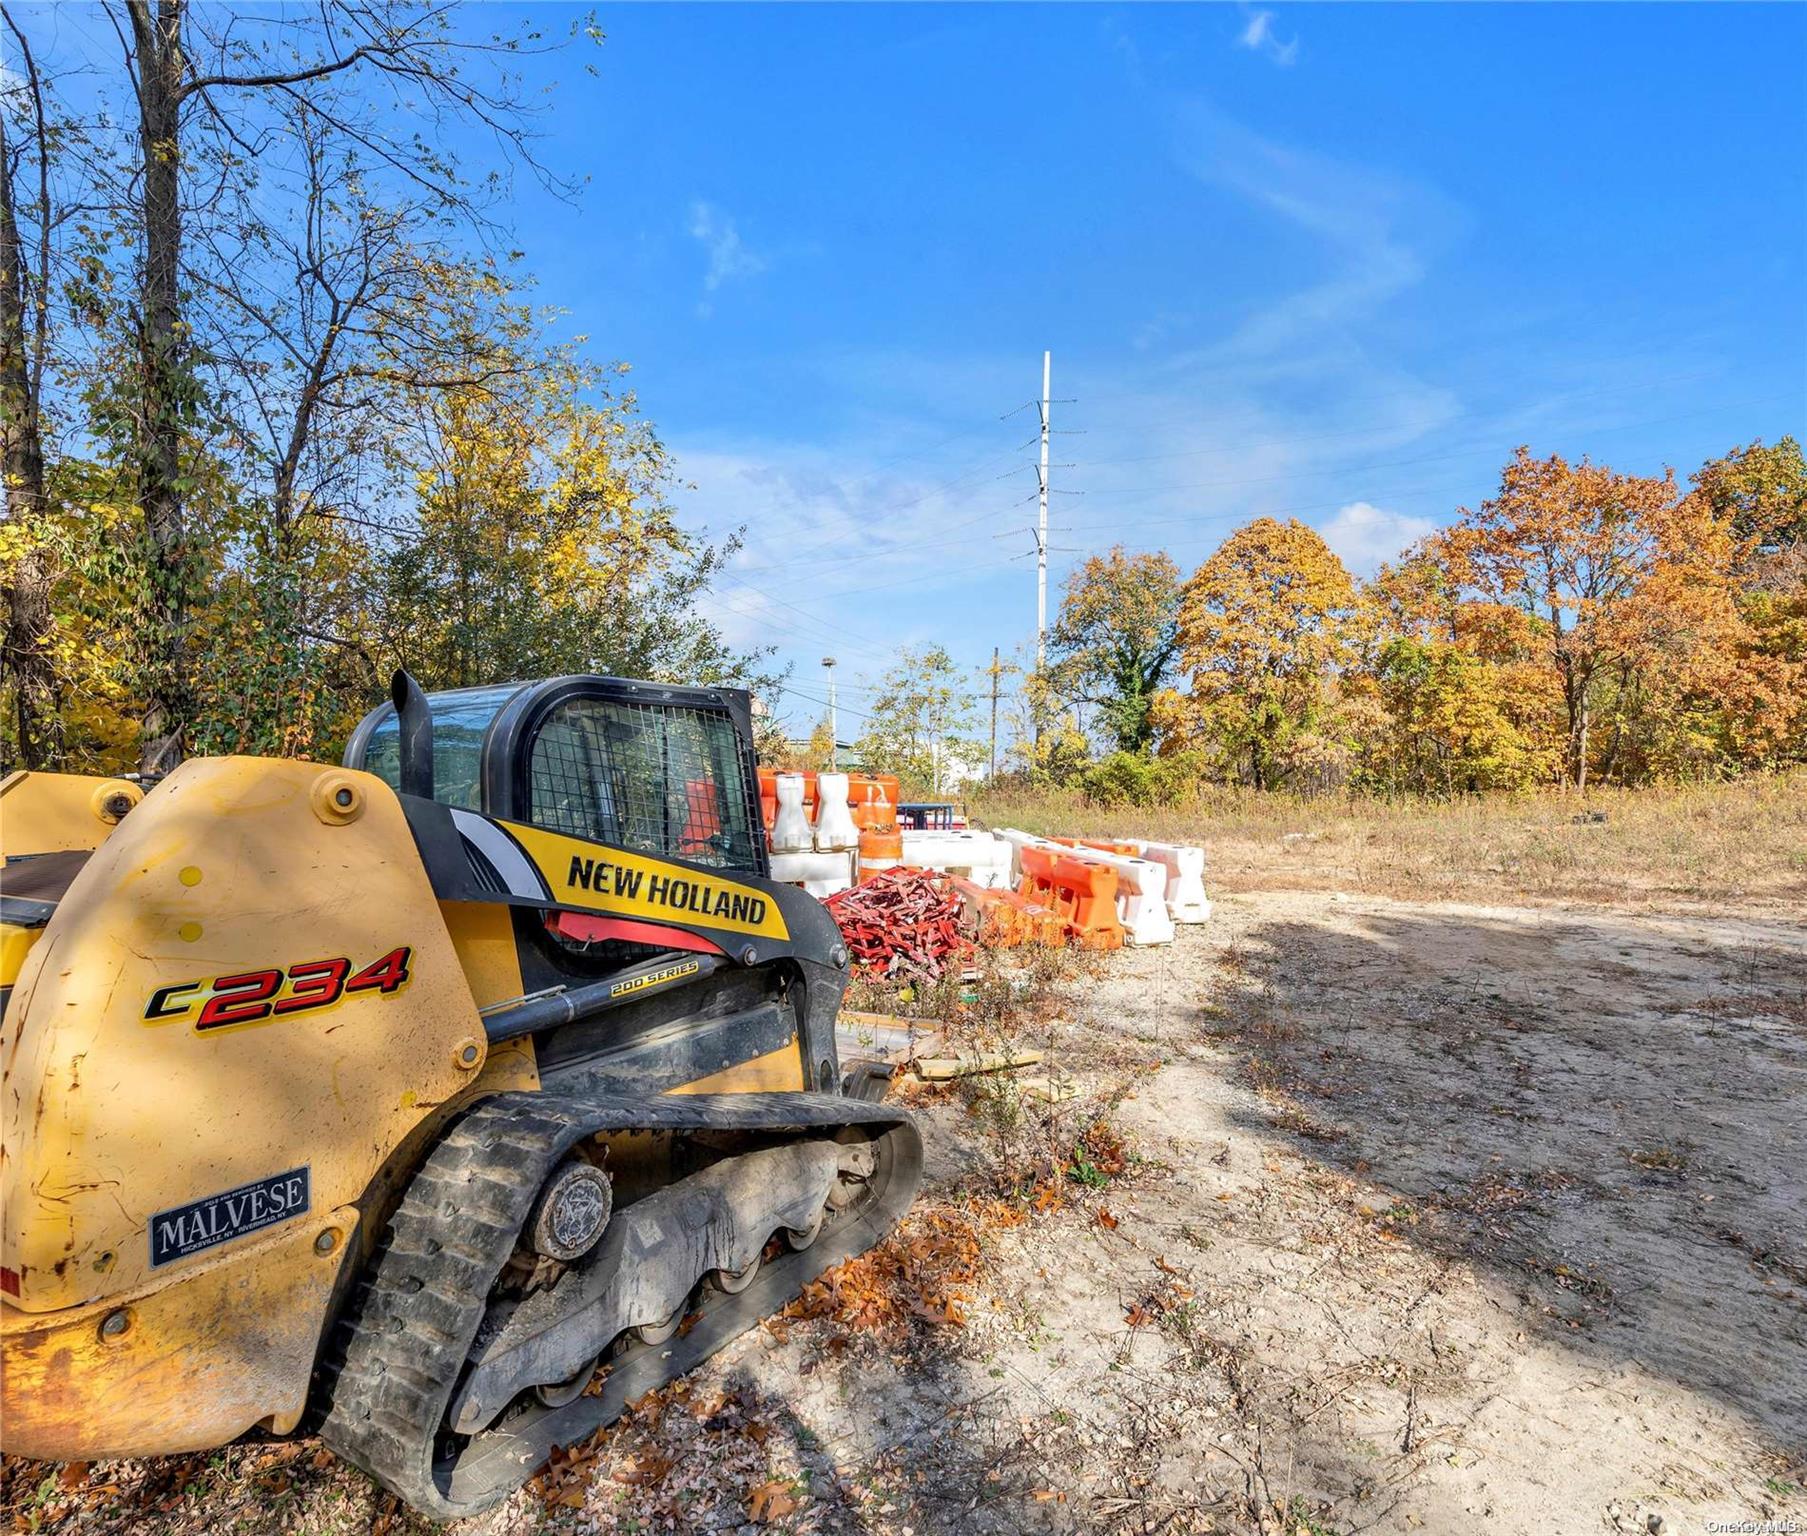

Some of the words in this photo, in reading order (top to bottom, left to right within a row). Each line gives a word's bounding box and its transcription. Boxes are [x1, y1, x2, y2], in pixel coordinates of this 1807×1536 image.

[567, 855, 643, 899] NEW
[647, 874, 766, 925] HOLLAND
[144, 946, 412, 1031] C234
[612, 977, 643, 995] 200
[647, 961, 698, 984] SERIES
[159, 1177, 304, 1254] MALVESE
